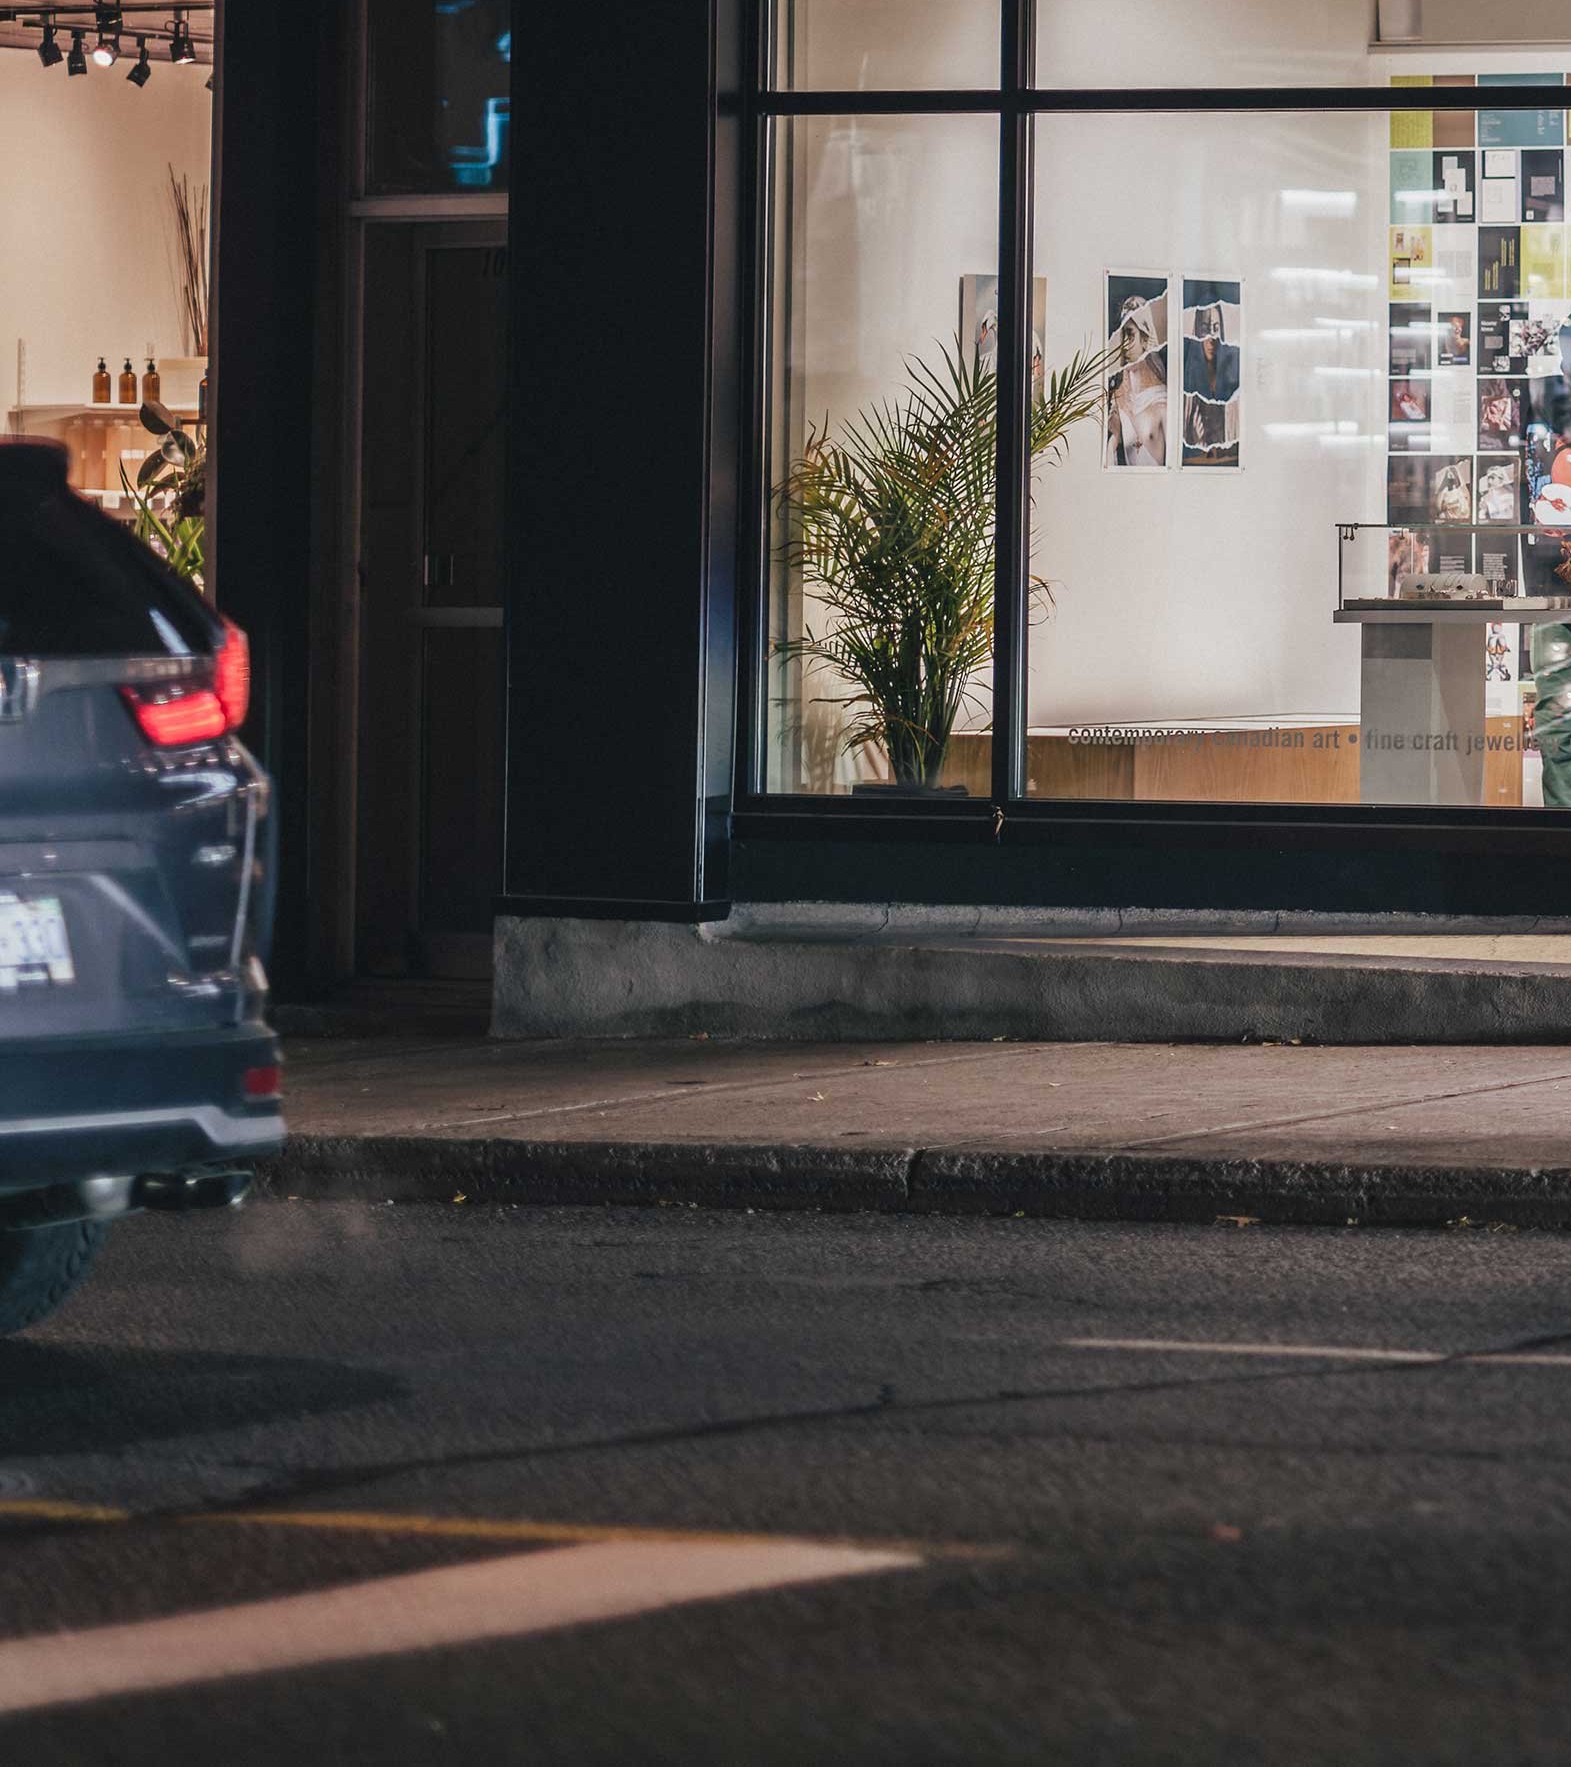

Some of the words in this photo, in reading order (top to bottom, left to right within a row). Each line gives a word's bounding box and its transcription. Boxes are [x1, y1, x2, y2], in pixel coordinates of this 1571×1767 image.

[1068, 725, 1206, 753] contemporary
[1213, 727, 1305, 749] canadian
[1312, 731, 1341, 749] art
[1366, 729, 1404, 750] fine
[1413, 731, 1458, 751] craft
